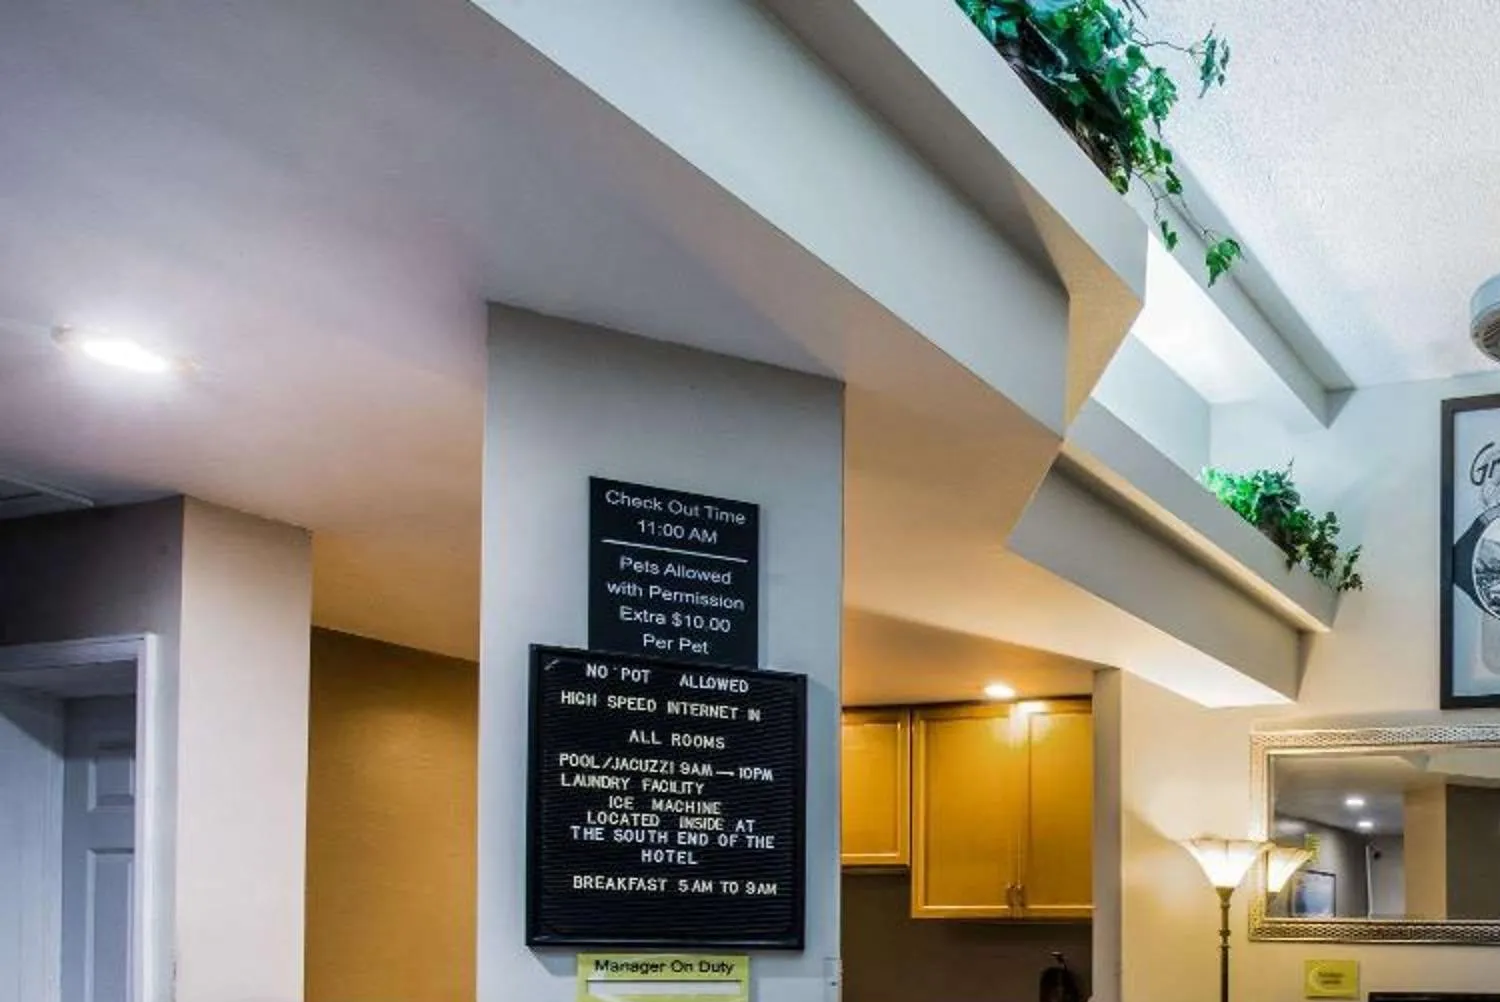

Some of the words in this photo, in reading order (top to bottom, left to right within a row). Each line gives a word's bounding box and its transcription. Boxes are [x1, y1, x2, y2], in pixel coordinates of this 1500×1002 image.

[605, 489, 663, 512] Check
[668, 499, 700, 515] Out
[704, 504, 746, 525] Time
[637, 519, 685, 540] 11:00
[688, 527, 718, 544] AM
[619, 555, 660, 575] Pets
[663, 563, 732, 585] Allowed
[607, 582, 643, 597] with
[649, 585, 745, 611] Permission
[619, 605, 667, 625] Extra
[671, 611, 732, 633] $10.00
[643, 633, 674, 650] Per
[679, 637, 709, 655] Pet
[586, 663, 608, 679] NO
[621, 667, 650, 684] POT
[680, 674, 749, 693] ALLOWED
[561, 690, 597, 707] HIGH
[607, 696, 657, 713] SPEED
[667, 701, 739, 720] INTERNET
[748, 708, 761, 722] IN
[629, 730, 663, 745] ALL
[671, 733, 725, 749] ROOMS
[559, 753, 675, 775] POOL/JACUZZI
[561, 773, 631, 791] LAUNDRY
[642, 779, 705, 795] FACILITY
[608, 796, 634, 810] ICE
[651, 799, 722, 815] MACHINE
[587, 811, 660, 827] LOCATED
[679, 817, 724, 831] INSIDE
[735, 820, 756, 833] AT
[570, 826, 604, 841] THE
[613, 830, 668, 844] SOUTH
[677, 831, 709, 847] END
[718, 834, 739, 848] OF
[746, 835, 775, 849] THE
[641, 849, 698, 865] HOTEL
[572, 875, 668, 892] BREAKFAST
[720, 880, 739, 894] TO
[745, 882, 778, 895] 9AM
[594, 959, 666, 976] Manager
[671, 960, 694, 973] On
[699, 960, 735, 975] Duty
